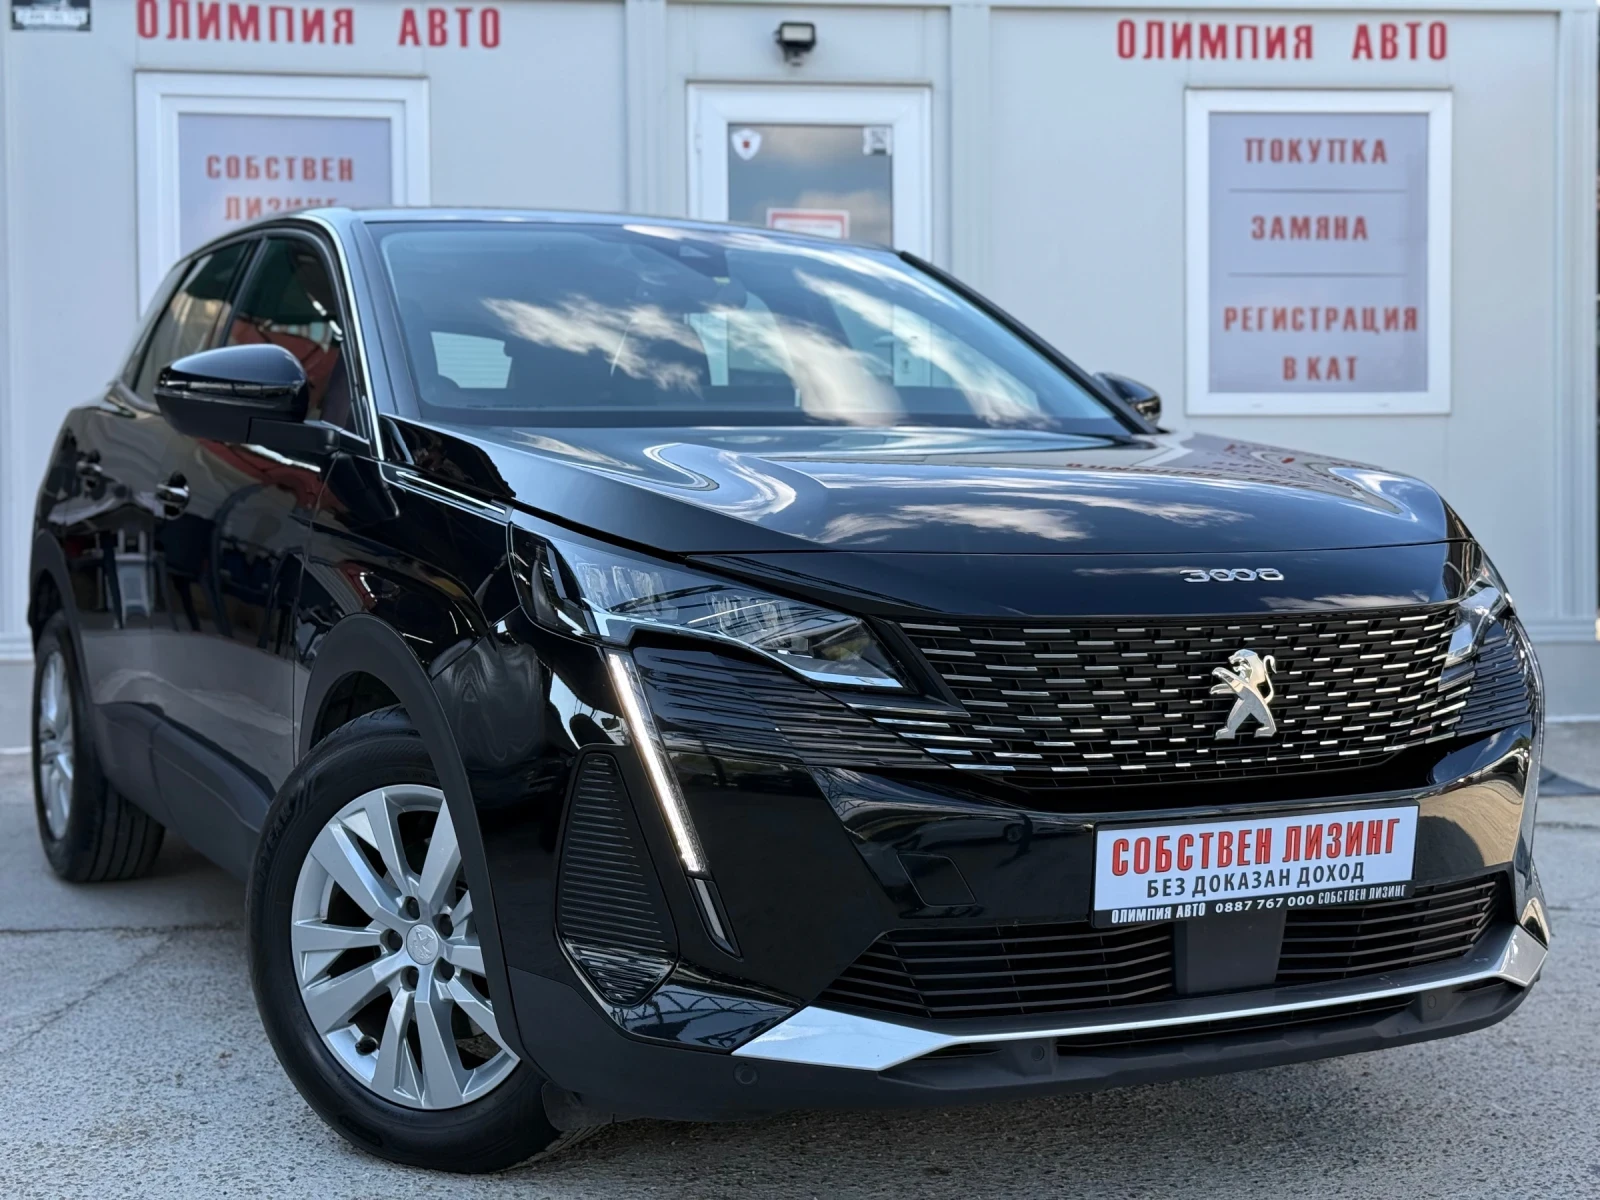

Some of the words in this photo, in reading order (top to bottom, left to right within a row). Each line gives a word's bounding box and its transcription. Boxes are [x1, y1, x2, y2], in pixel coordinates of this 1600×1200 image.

[136, 0, 354, 45] ОЛИМПИЯ
[398, 7, 501, 48] АВТО
[1117, 20, 1313, 60] ОЛИМПИЯ
[1352, 21, 1447, 60] АВТО
[1244, 138, 1387, 164] ПОКУПКА
[207, 155, 353, 182] СОБСТВЕН
[1251, 215, 1368, 241] ЗАМЯНА
[1224, 306, 1418, 333] РЕГИСТРАЦИЯ
[1283, 356, 1296, 381] В
[1306, 356, 1358, 381] КАТ
[1179, 567, 1284, 583] 3008
[1111, 827, 1273, 877] СОБСТВЕН
[1282, 818, 1400, 863] ЛИЗИНГ
[1147, 878, 1186, 899] БЕЗ
[1191, 868, 1291, 898] ДОКАЗАН
[1297, 862, 1364, 888] ДОХОД
[1111, 906, 1172, 924] ОЛИМПИЯ
[1176, 902, 1206, 918] АВТО
[1215, 900, 1252, 914] 0887
[1257, 897, 1284, 910] 767
[1287, 894, 1315, 907] 000
[1318, 888, 1365, 904] СОБСТВЕН
[1367, 884, 1407, 900] ЛИЗИНГ
